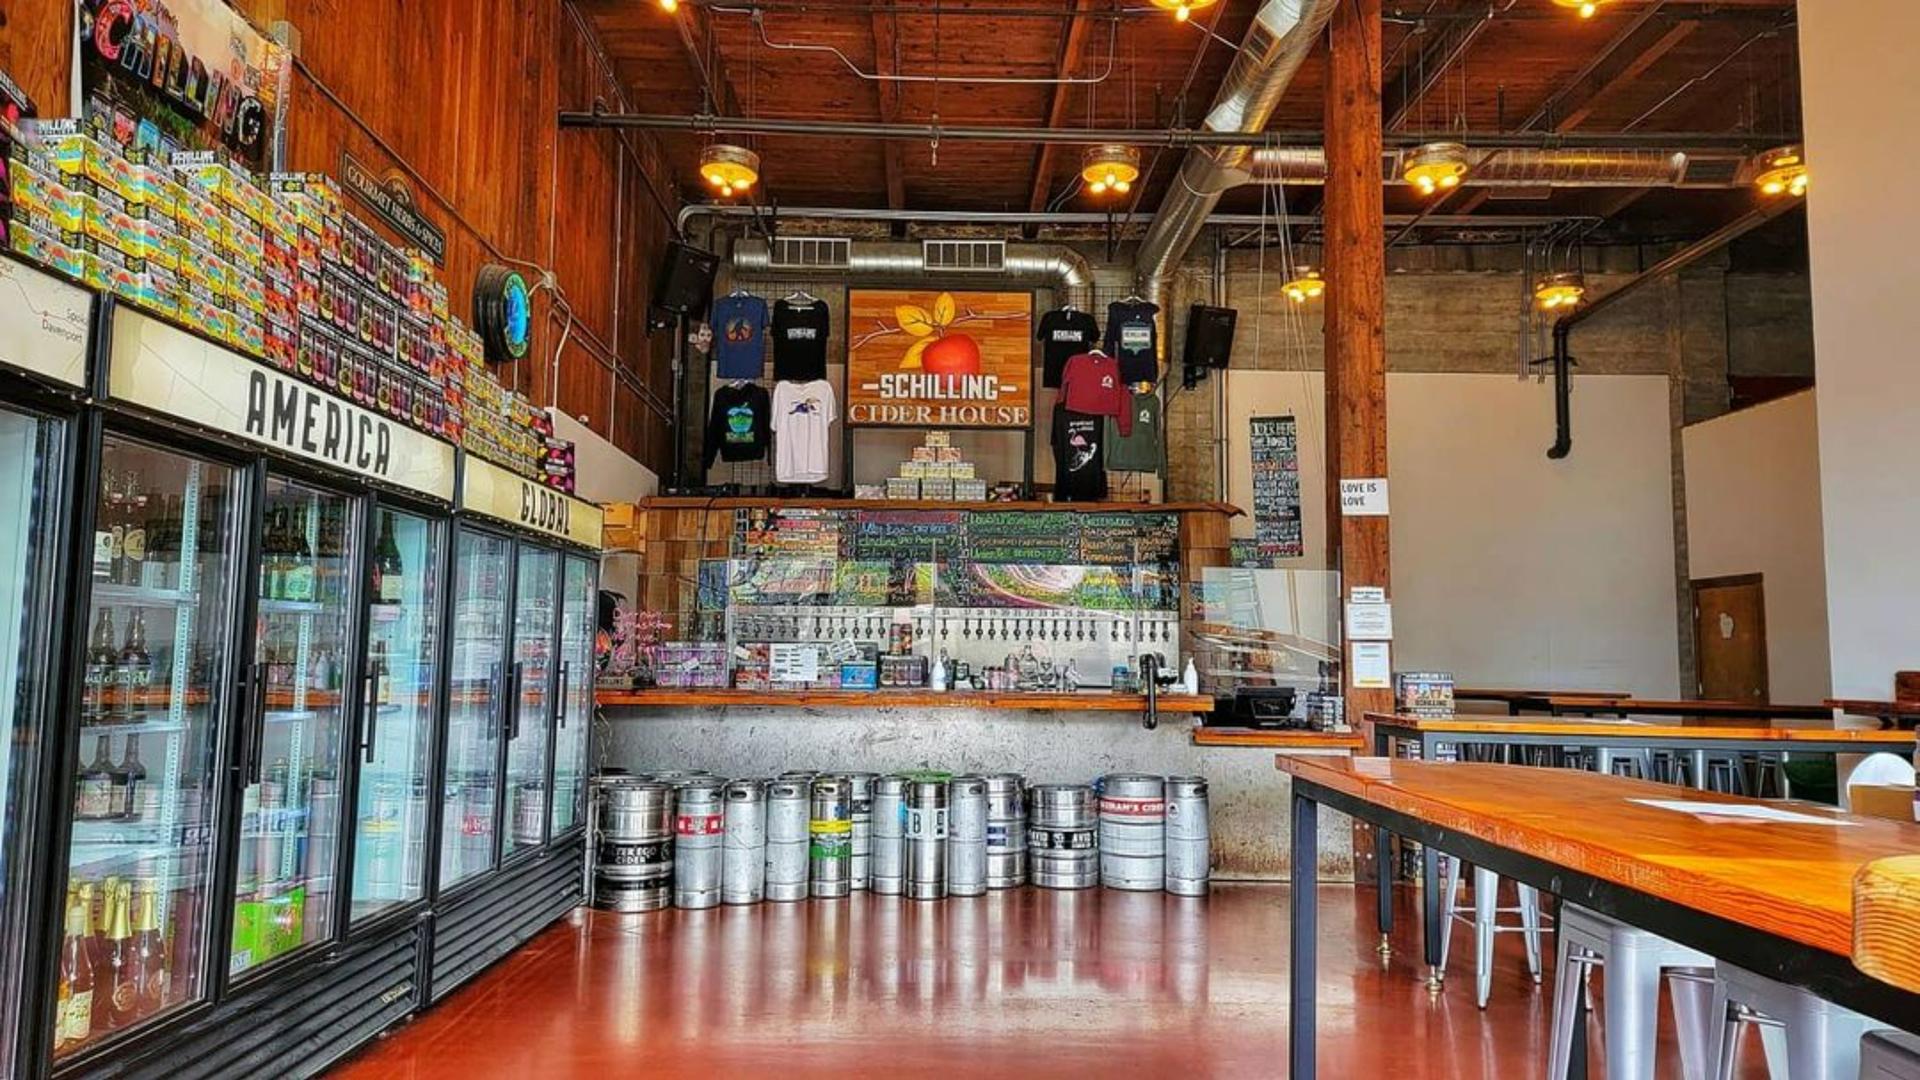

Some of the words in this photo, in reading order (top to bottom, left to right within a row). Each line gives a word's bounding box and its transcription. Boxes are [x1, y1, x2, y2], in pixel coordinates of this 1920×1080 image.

[42, 319, 82, 342] Davenport
[880, 374, 998, 400] SCHILLING
[246, 369, 390, 475] AMERICA
[850, 404, 932, 424] CIDER
[940, 405, 1030, 425] HOUSE
[1342, 482, 1365, 493] LOVE
[1367, 482, 1377, 493] IS
[521, 482, 569, 536] GLOBAL
[1343, 496, 1365, 506] LOVE
